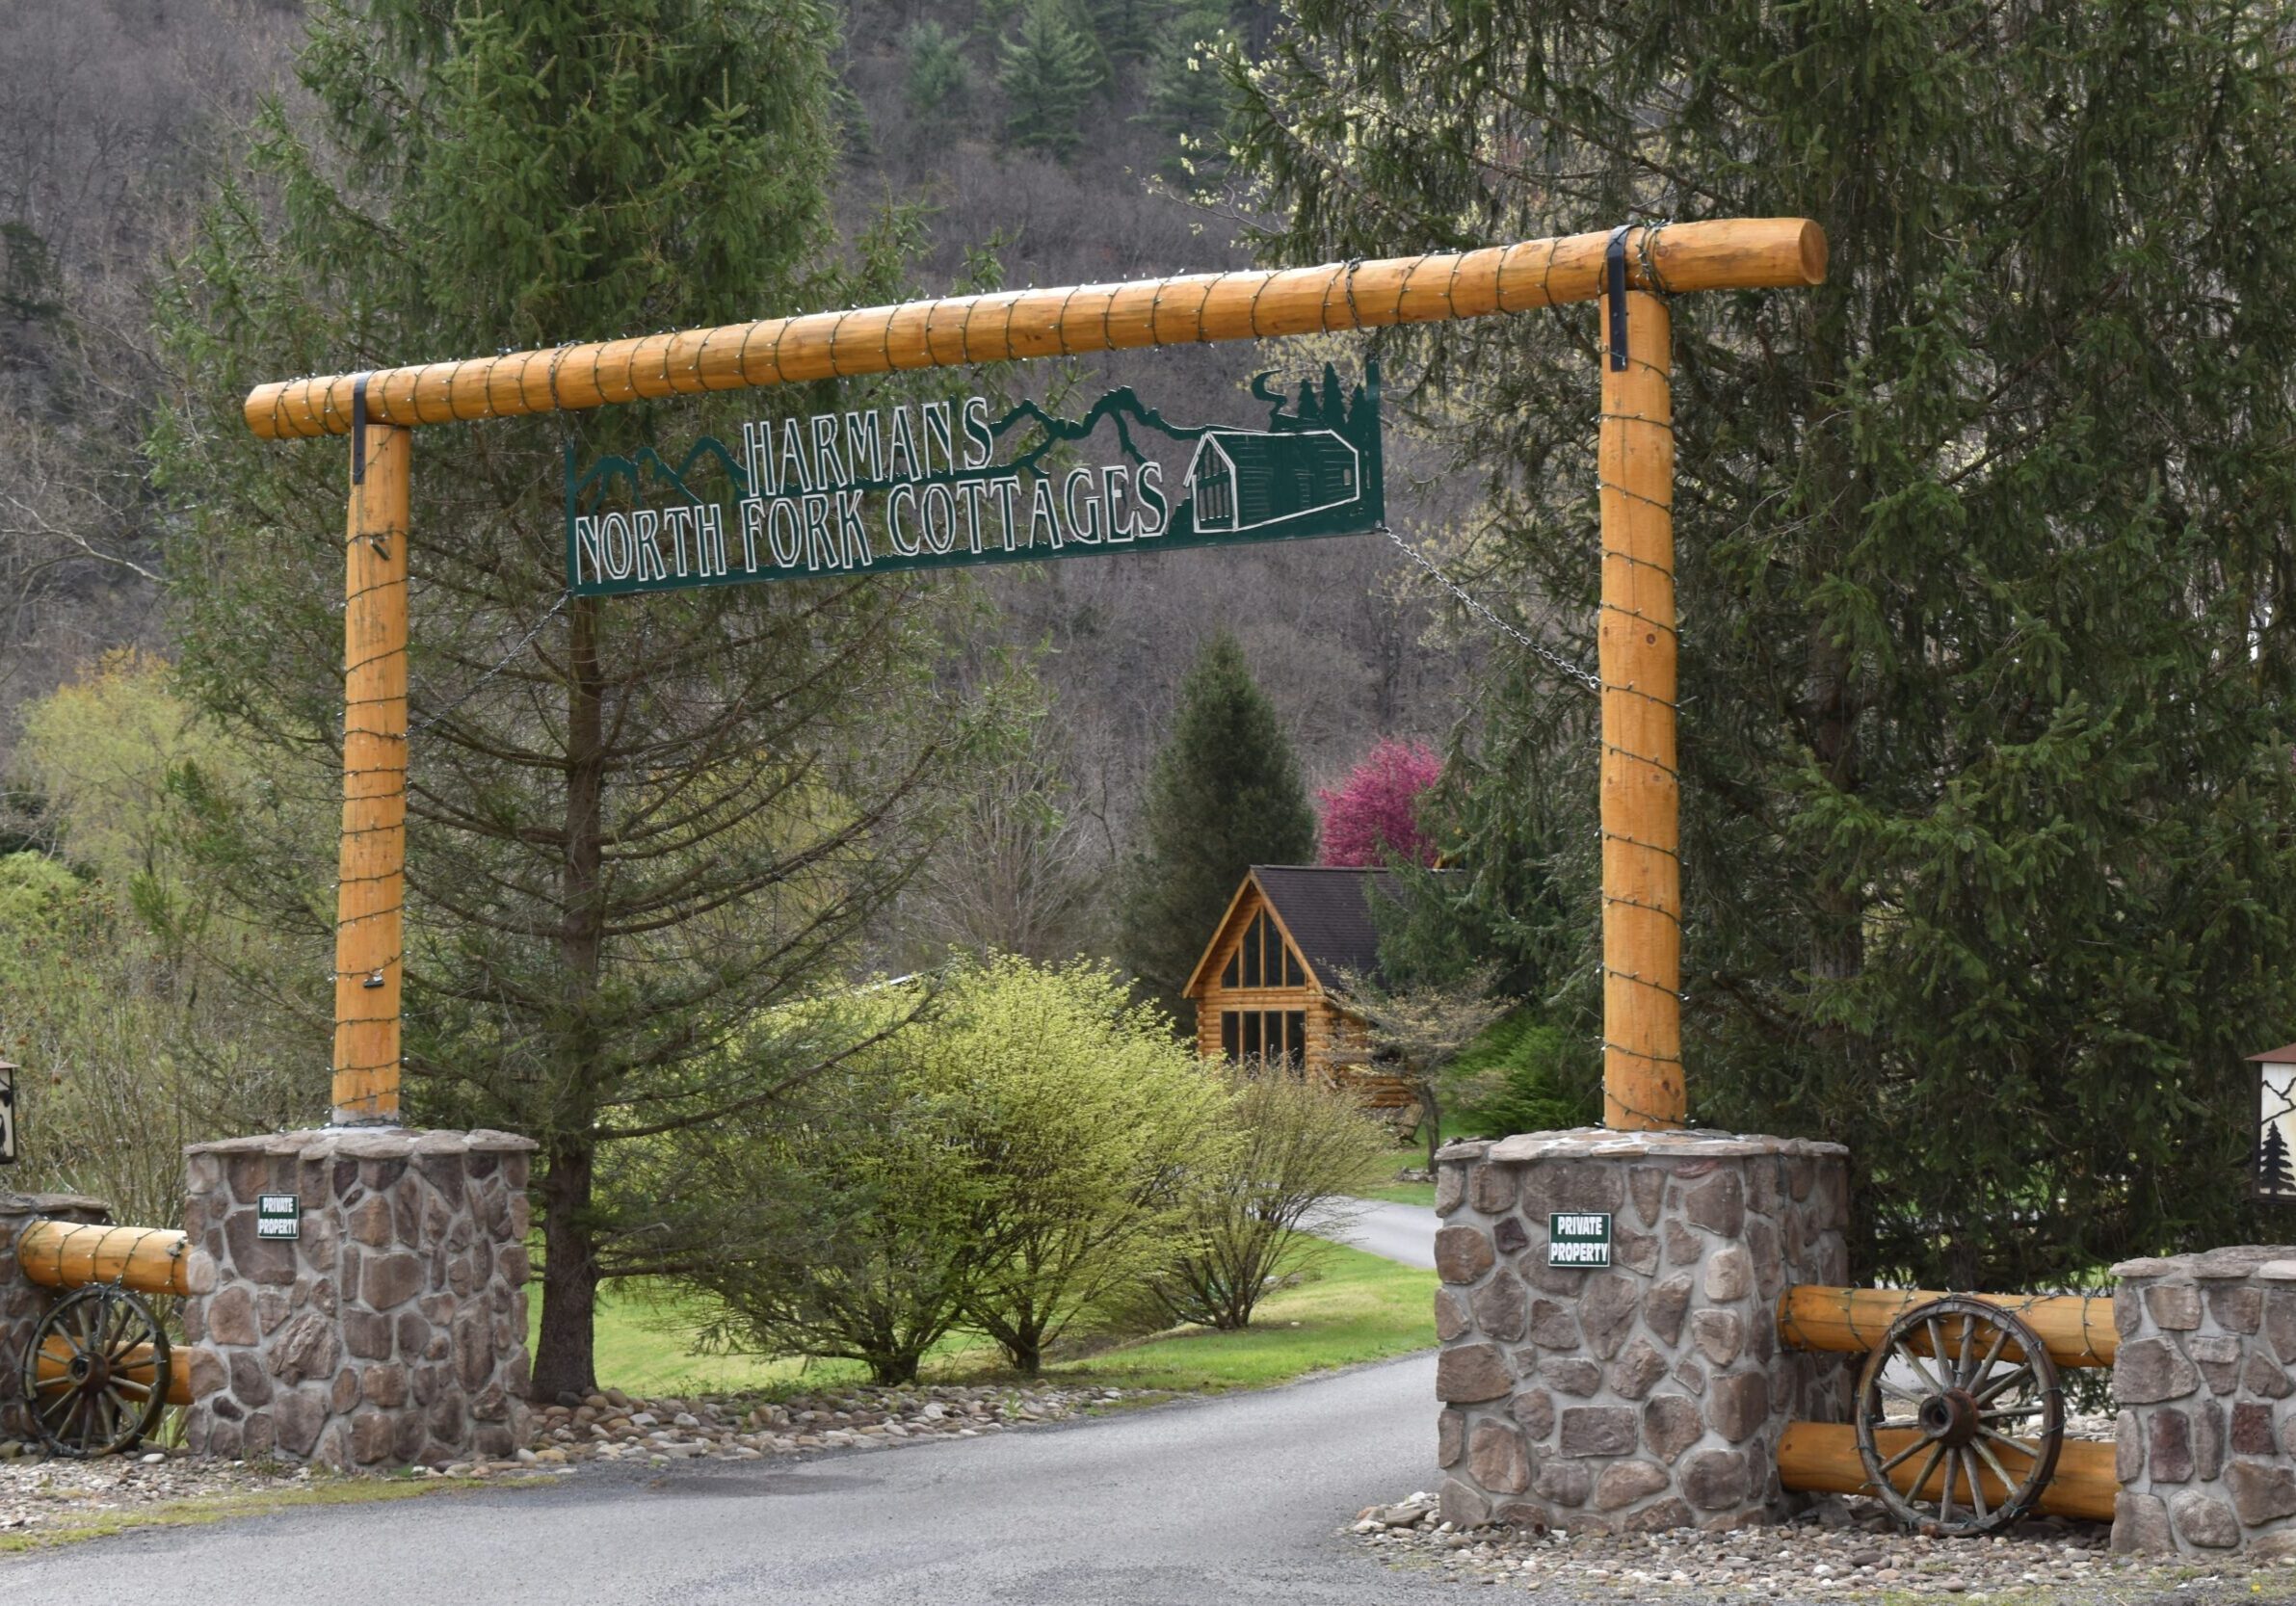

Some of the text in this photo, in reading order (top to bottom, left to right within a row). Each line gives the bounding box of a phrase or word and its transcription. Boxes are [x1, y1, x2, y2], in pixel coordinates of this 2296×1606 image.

[743, 396, 993, 498] HARMANS
[575, 461, 1170, 585] NORTH FORK COTTAGES
[262, 1197, 294, 1213] PRIVATE
[258, 1218, 298, 1234] PROPERTY
[1557, 1216, 1602, 1235] PRIVATE
[1550, 1242, 1608, 1262] PROPERTY
